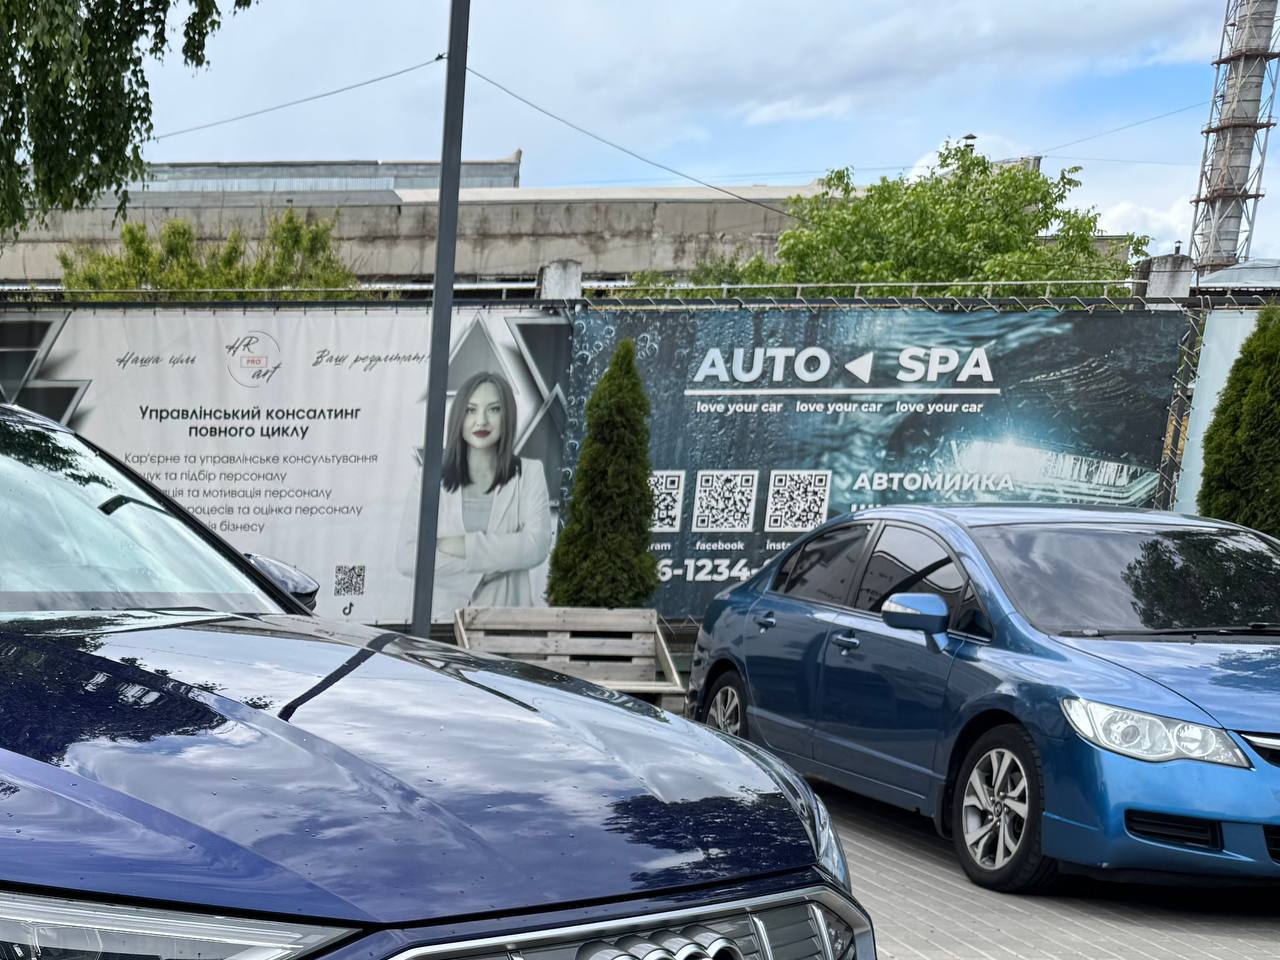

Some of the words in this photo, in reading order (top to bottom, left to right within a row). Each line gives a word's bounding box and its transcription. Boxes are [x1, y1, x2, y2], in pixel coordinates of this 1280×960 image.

[225, 335, 259, 357] HR
[116, 352, 163, 370] Наша
[246, 358, 261, 366] PRO
[312, 349, 349, 367] Ваш
[693, 346, 831, 382] AUTO
[896, 346, 994, 382] SPA
[251, 362, 282, 383] art
[139, 405, 261, 422] Управлінський
[266, 407, 361, 420] консалтинг
[696, 401, 725, 413] love
[727, 403, 760, 416] your
[761, 403, 783, 413] car
[795, 401, 824, 413] love
[826, 403, 859, 416] your
[860, 403, 883, 413] car
[895, 401, 924, 413] love
[926, 403, 959, 416] your
[961, 403, 983, 413] car
[188, 425, 255, 438] повного
[260, 425, 309, 440] циклу
[184, 454, 197, 464] та
[199, 452, 280, 466] управлінське
[282, 453, 378, 466] консультування
[164, 471, 177, 481] та
[180, 469, 216, 483] підбір
[219, 471, 287, 484] персоналу
[852, 470, 1015, 491] АВТОМИЙКА
[187, 488, 200, 498] та
[202, 487, 261, 500] мотивація
[264, 488, 332, 500] персоналу
[186, 504, 234, 517] роцесів
[237, 506, 250, 516] та
[253, 504, 292, 517] оцінка
[294, 505, 363, 517] персоналу
[219, 520, 265, 534] бізнесу
[695, 541, 745, 551] facebook
